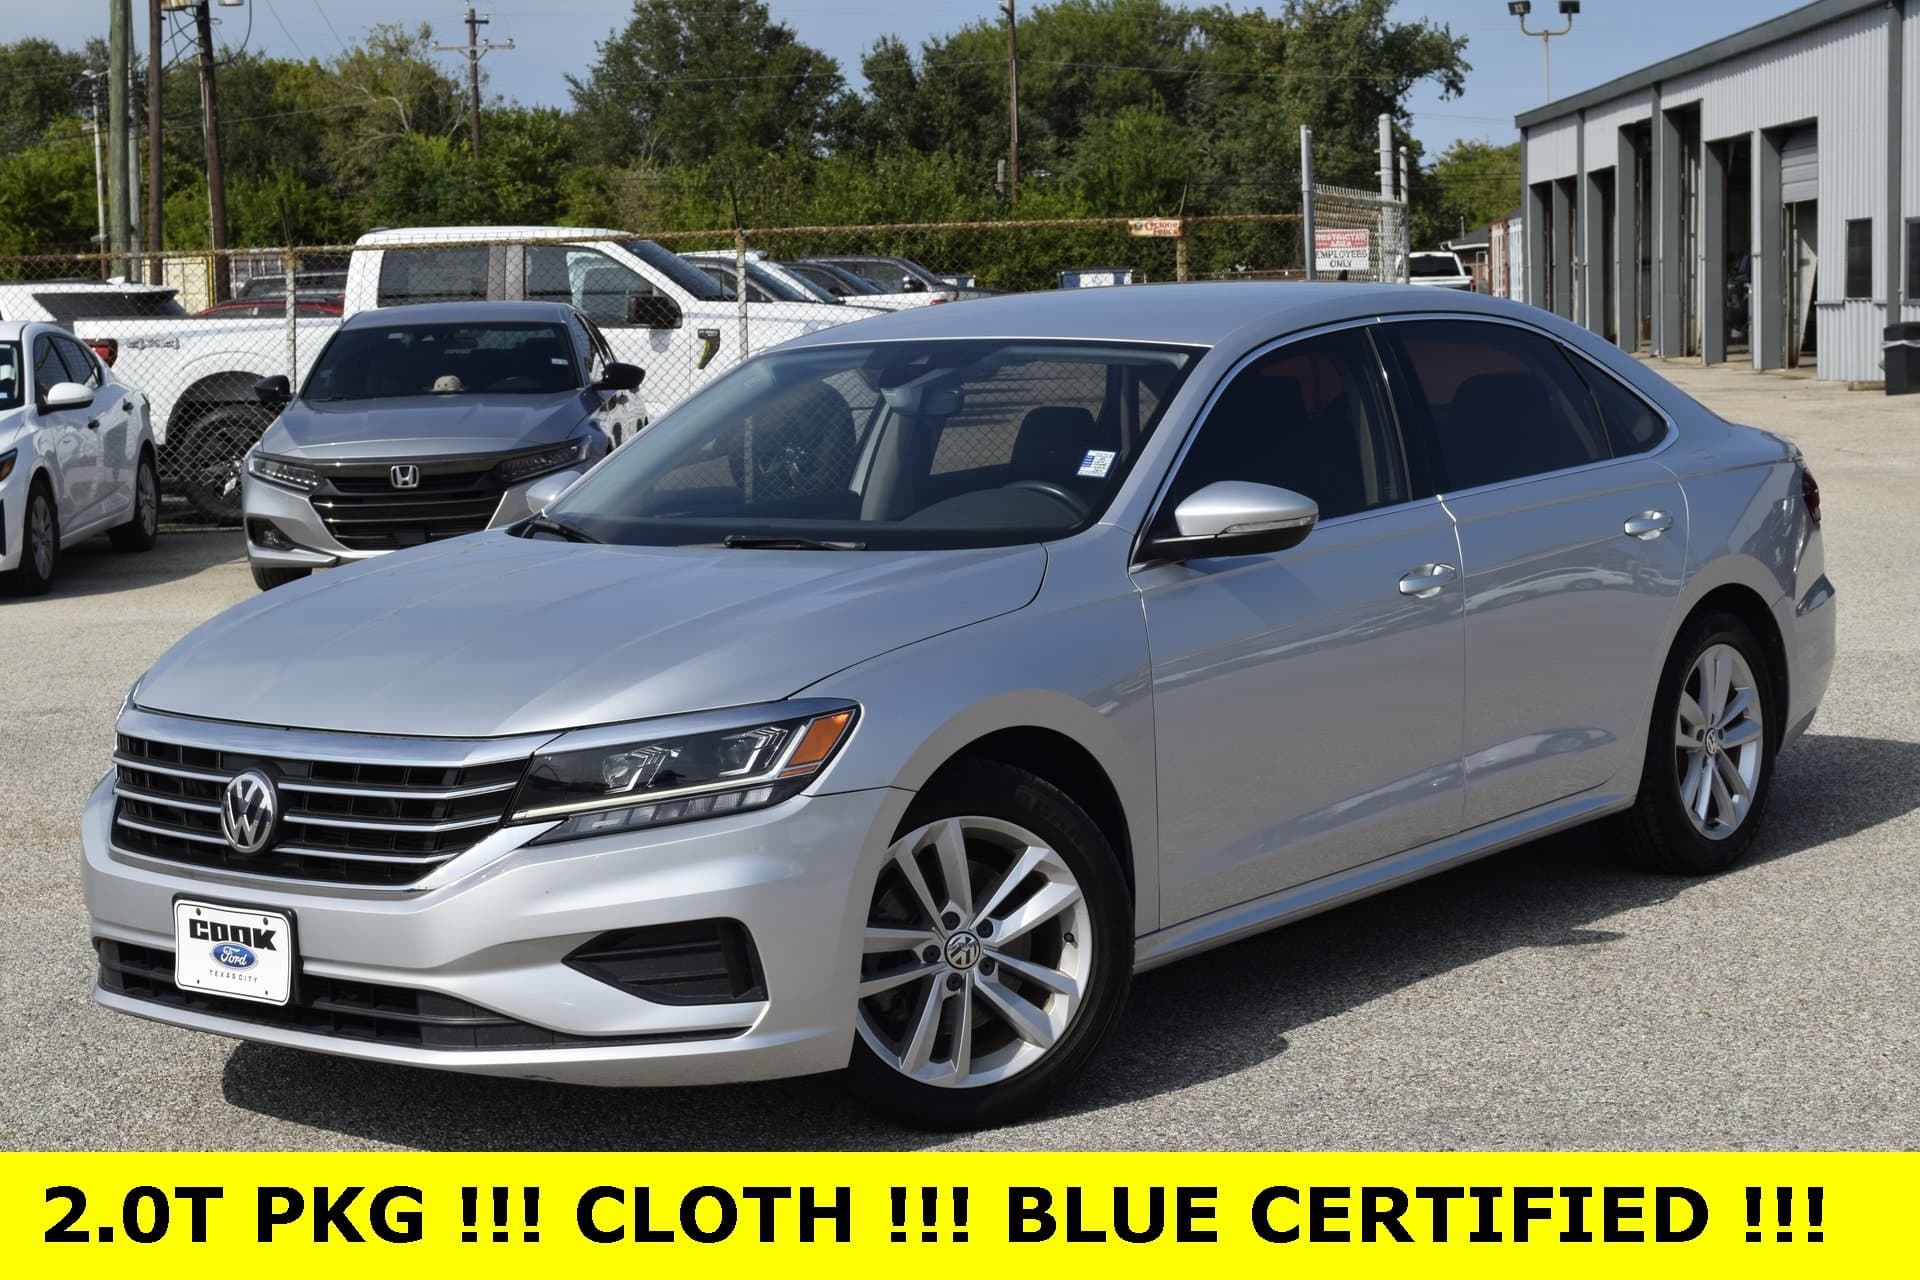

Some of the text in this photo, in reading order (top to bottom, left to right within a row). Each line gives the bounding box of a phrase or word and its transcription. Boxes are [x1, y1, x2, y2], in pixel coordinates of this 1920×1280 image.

[1315, 249, 1367, 258] EMPLOYEES
[1329, 259, 1351, 267] ONLY
[189, 918, 277, 951] COOK
[220, 945, 248, 966] Ford
